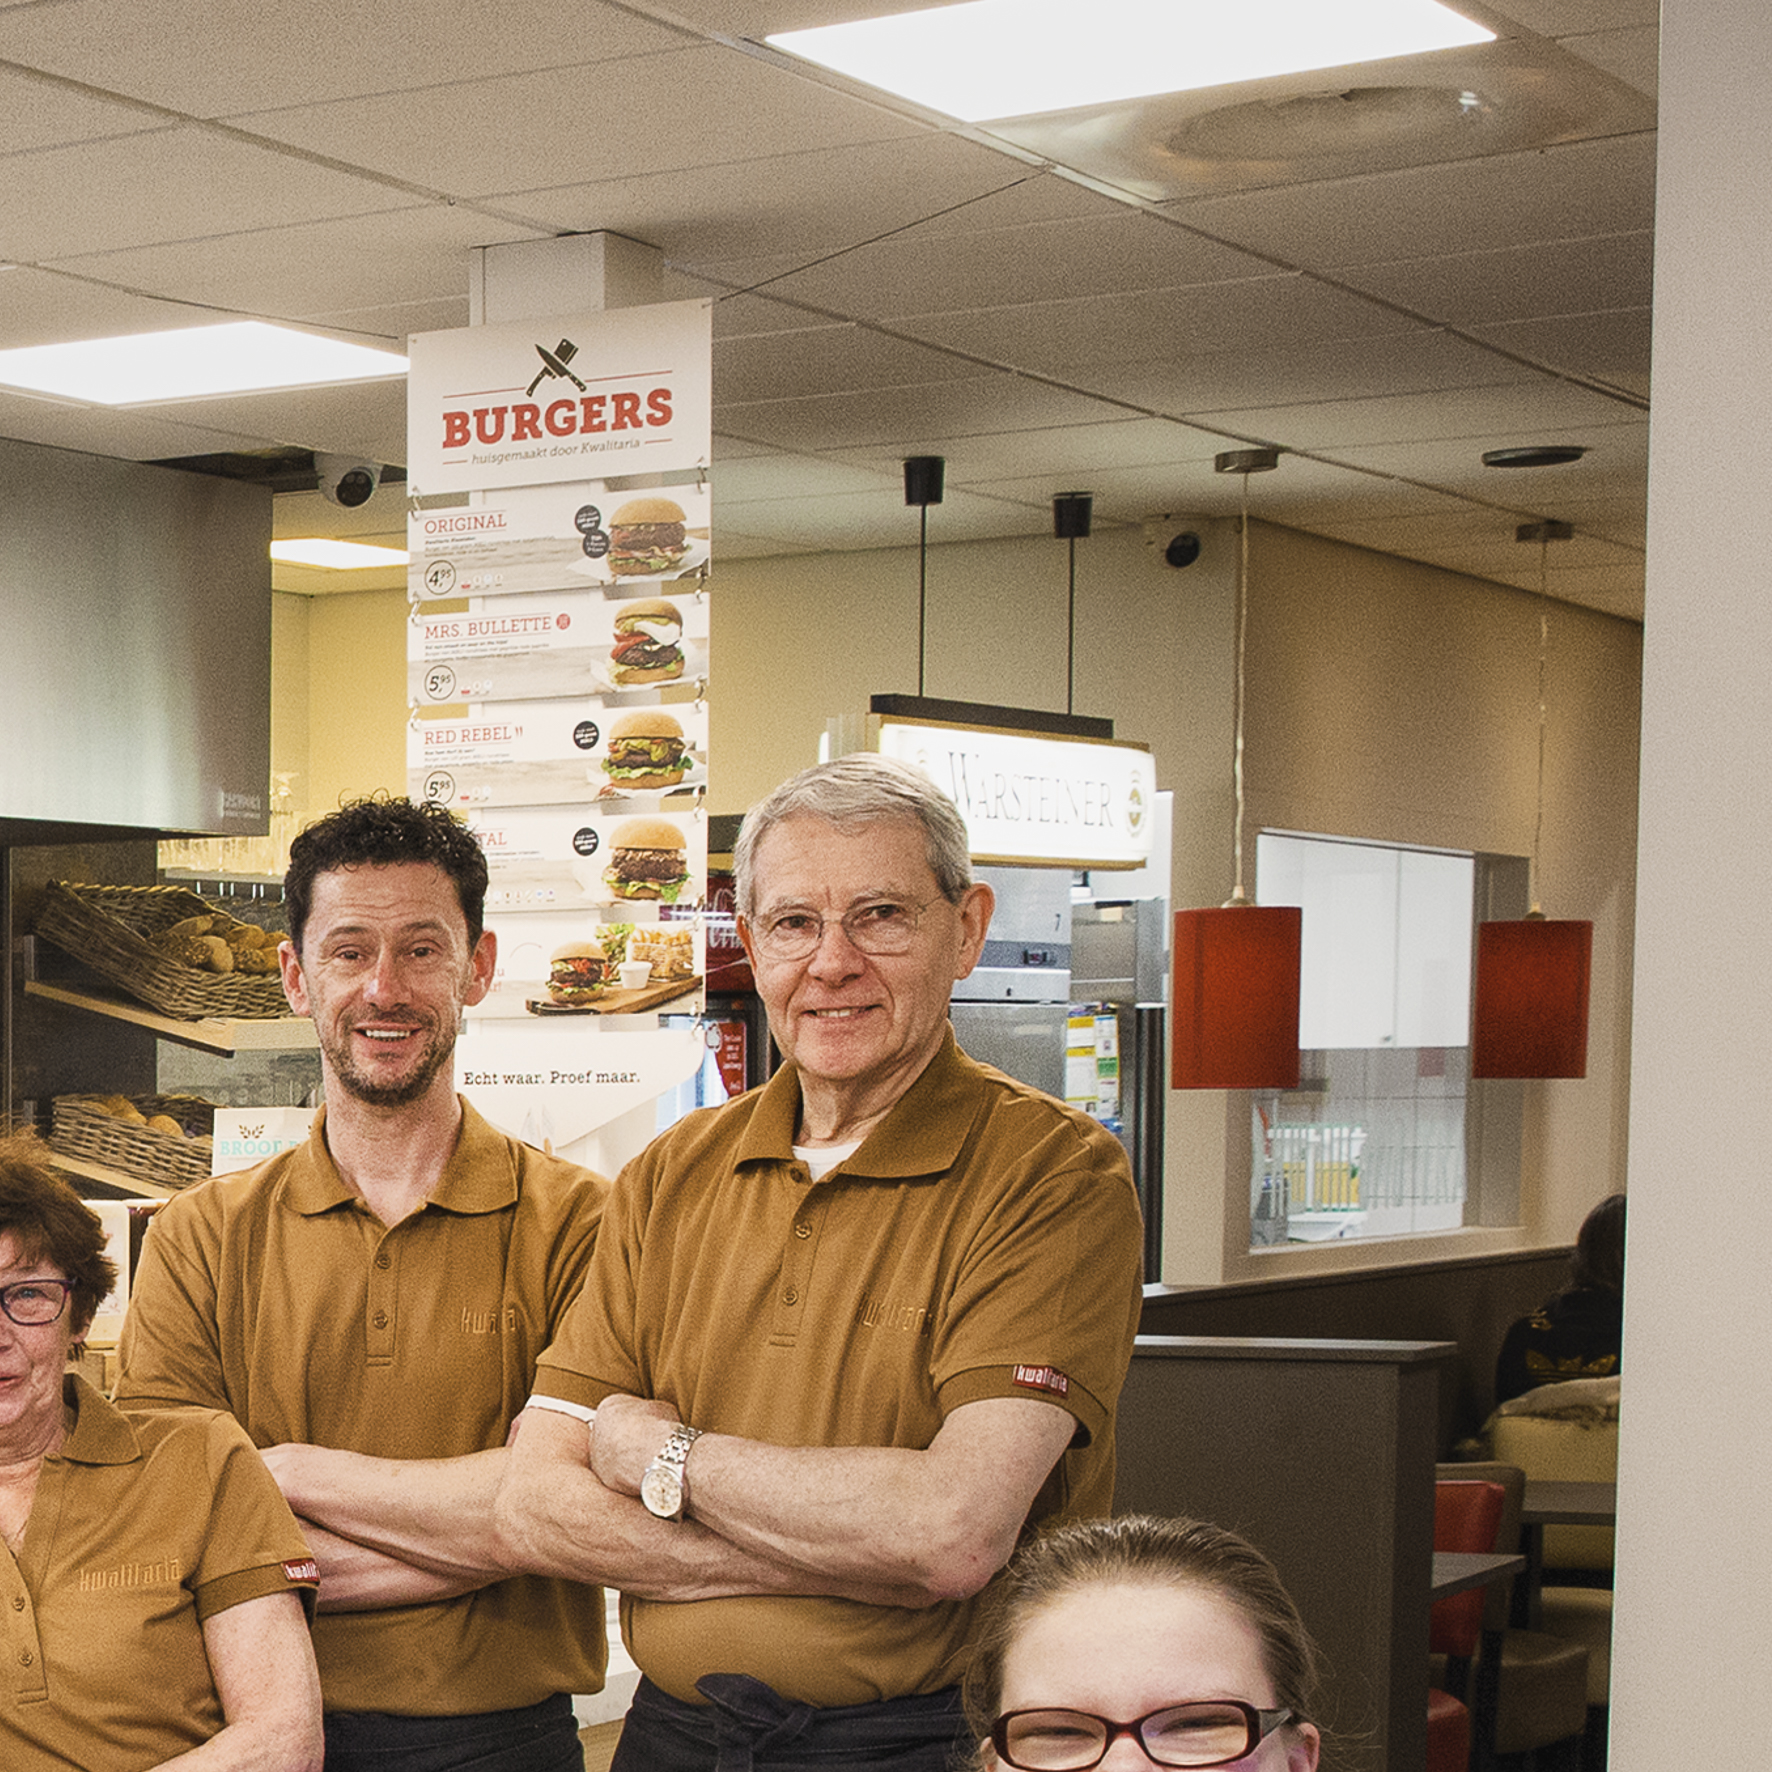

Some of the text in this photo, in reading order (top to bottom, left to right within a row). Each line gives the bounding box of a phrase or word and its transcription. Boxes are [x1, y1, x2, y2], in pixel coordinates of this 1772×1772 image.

[442, 388, 673, 449] BURGERS
[471, 438, 641, 466] huisgemaakt door Kwalitaria
[424, 513, 507, 535] ORIGINAL
[424, 622, 463, 640] MRS.
[467, 615, 552, 637] BULLETTE
[424, 725, 513, 746] RED REBEL
[948, 751, 1114, 828] WARSTEINER
[463, 1069, 641, 1087] Echt waar. Proef maar.
